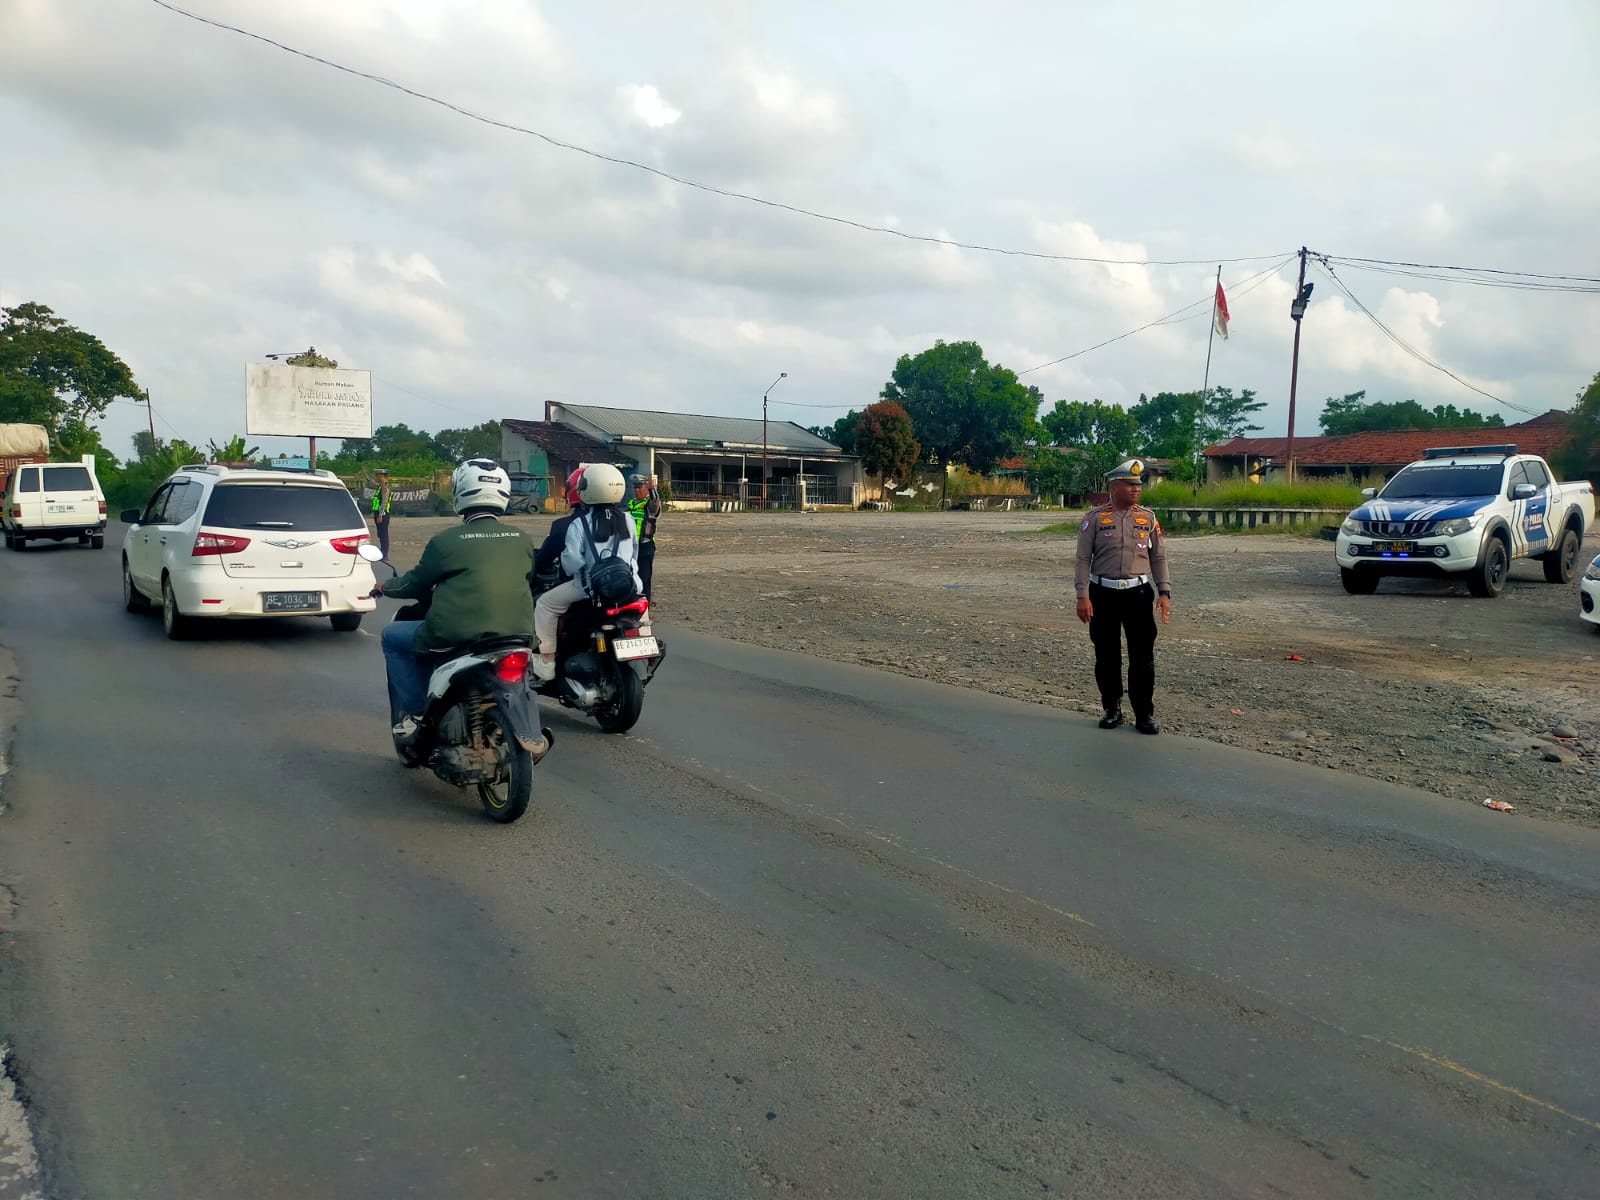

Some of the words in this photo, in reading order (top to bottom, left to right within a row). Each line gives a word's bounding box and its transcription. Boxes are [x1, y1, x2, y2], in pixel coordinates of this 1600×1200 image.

[337, 401, 365, 409] PADANG
[267, 595, 279, 604] BE
[283, 594, 304, 604] 1034
[615, 640, 625, 650] BE
